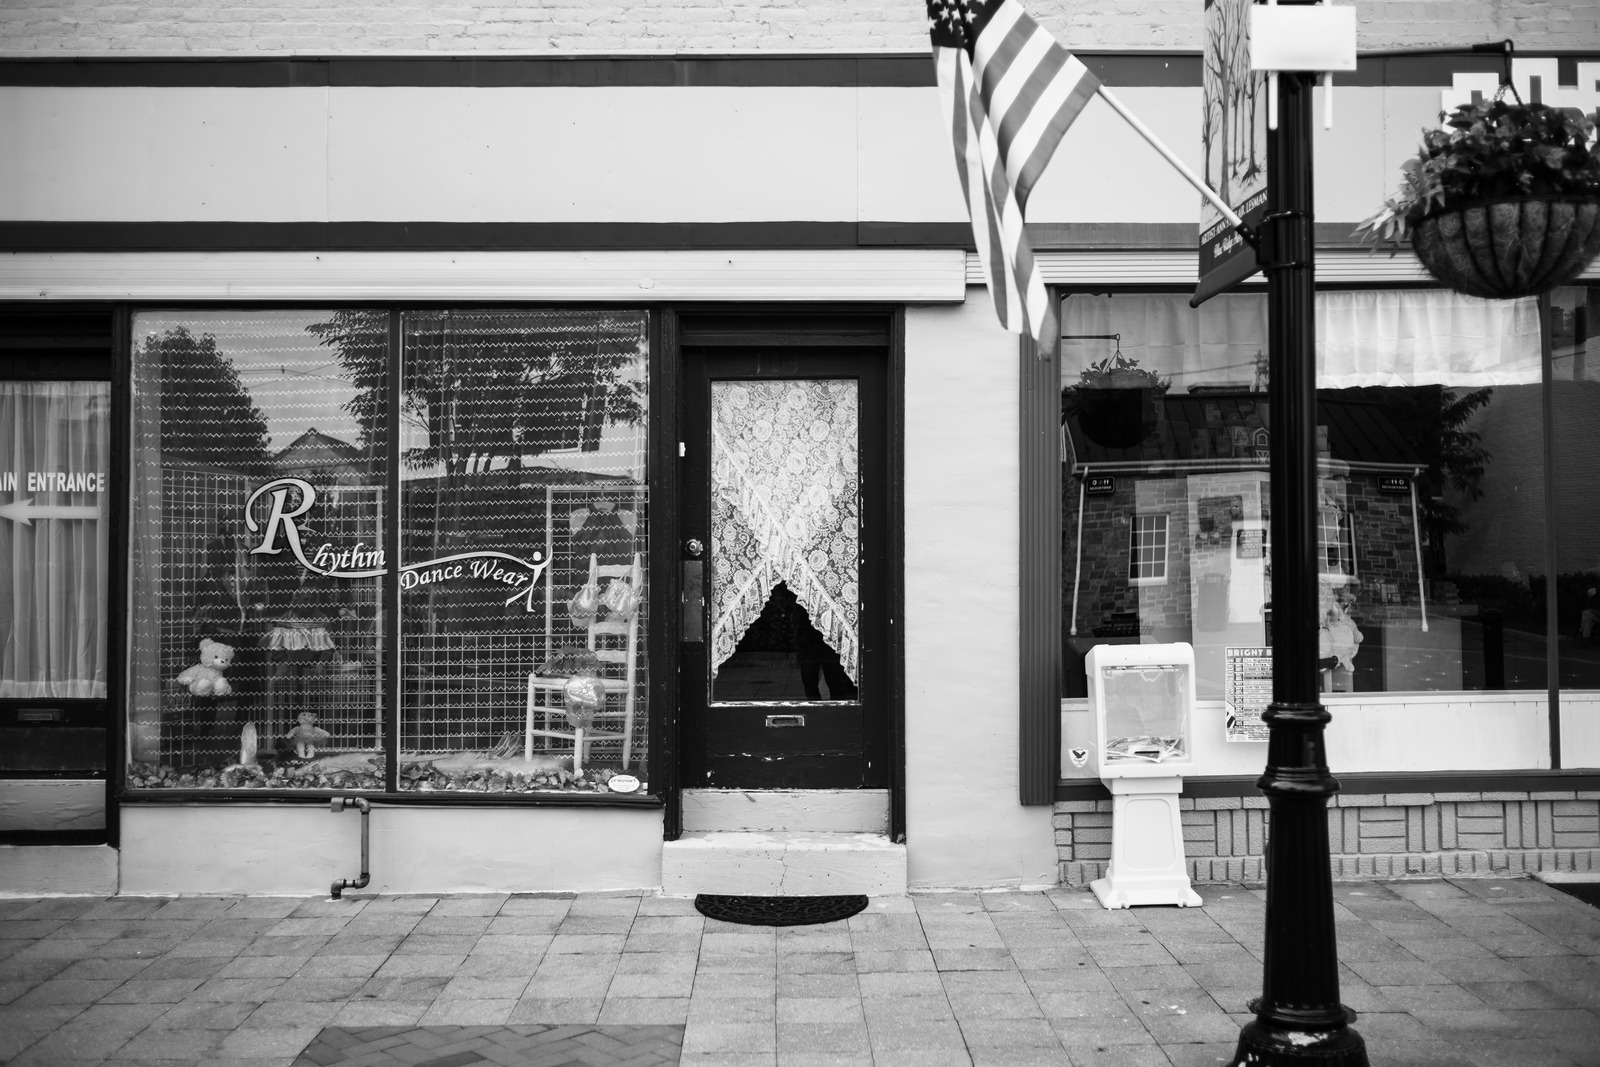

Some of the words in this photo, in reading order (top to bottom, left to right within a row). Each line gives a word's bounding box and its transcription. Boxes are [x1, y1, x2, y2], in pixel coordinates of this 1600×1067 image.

[0, 472, 18, 492] IN
[28, 472, 105, 492] ENTRANCE
[245, 478, 387, 578] Rhythm
[400, 565, 463, 590] Dance
[470, 559, 528, 587] Wear
